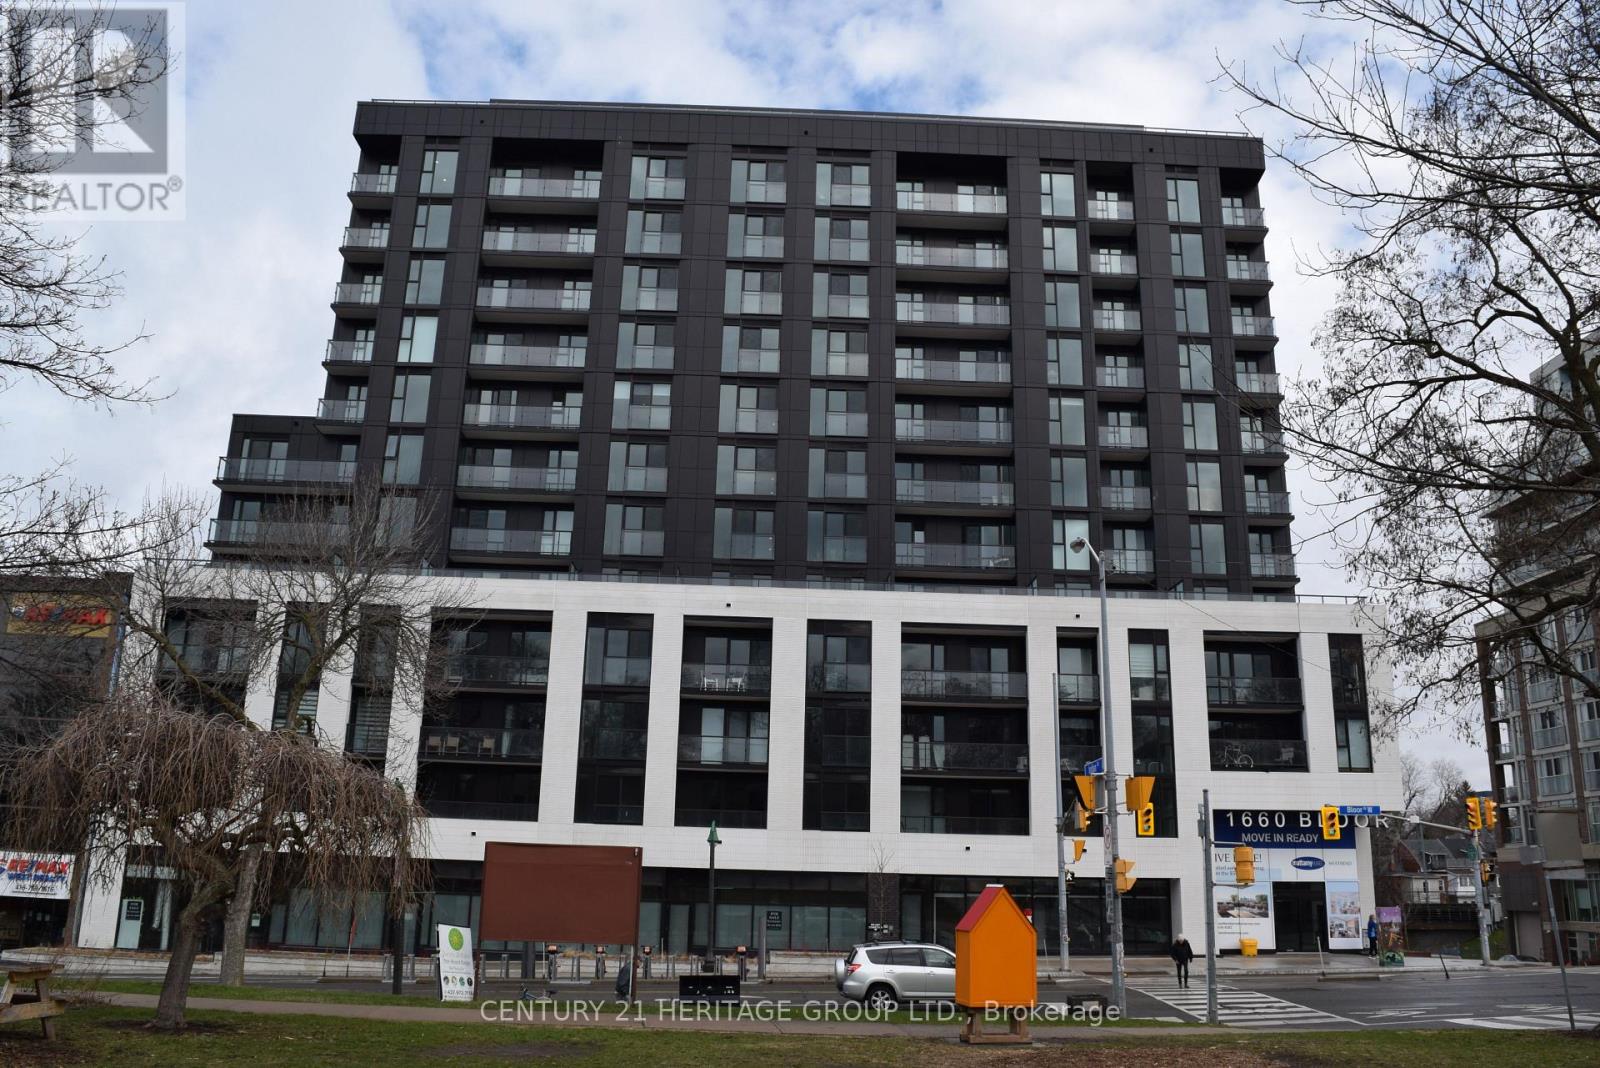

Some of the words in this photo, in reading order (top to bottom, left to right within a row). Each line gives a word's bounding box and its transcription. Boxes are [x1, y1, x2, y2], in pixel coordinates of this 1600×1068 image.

[1226, 811, 1286, 828] 1660
[1241, 833, 1271, 843] MOVE
[1273, 833, 1283, 843] IN
[1286, 833, 1318, 844] READY
[1214, 853, 1230, 863] IVE
[7, 859, 68, 873] RE/MAX
